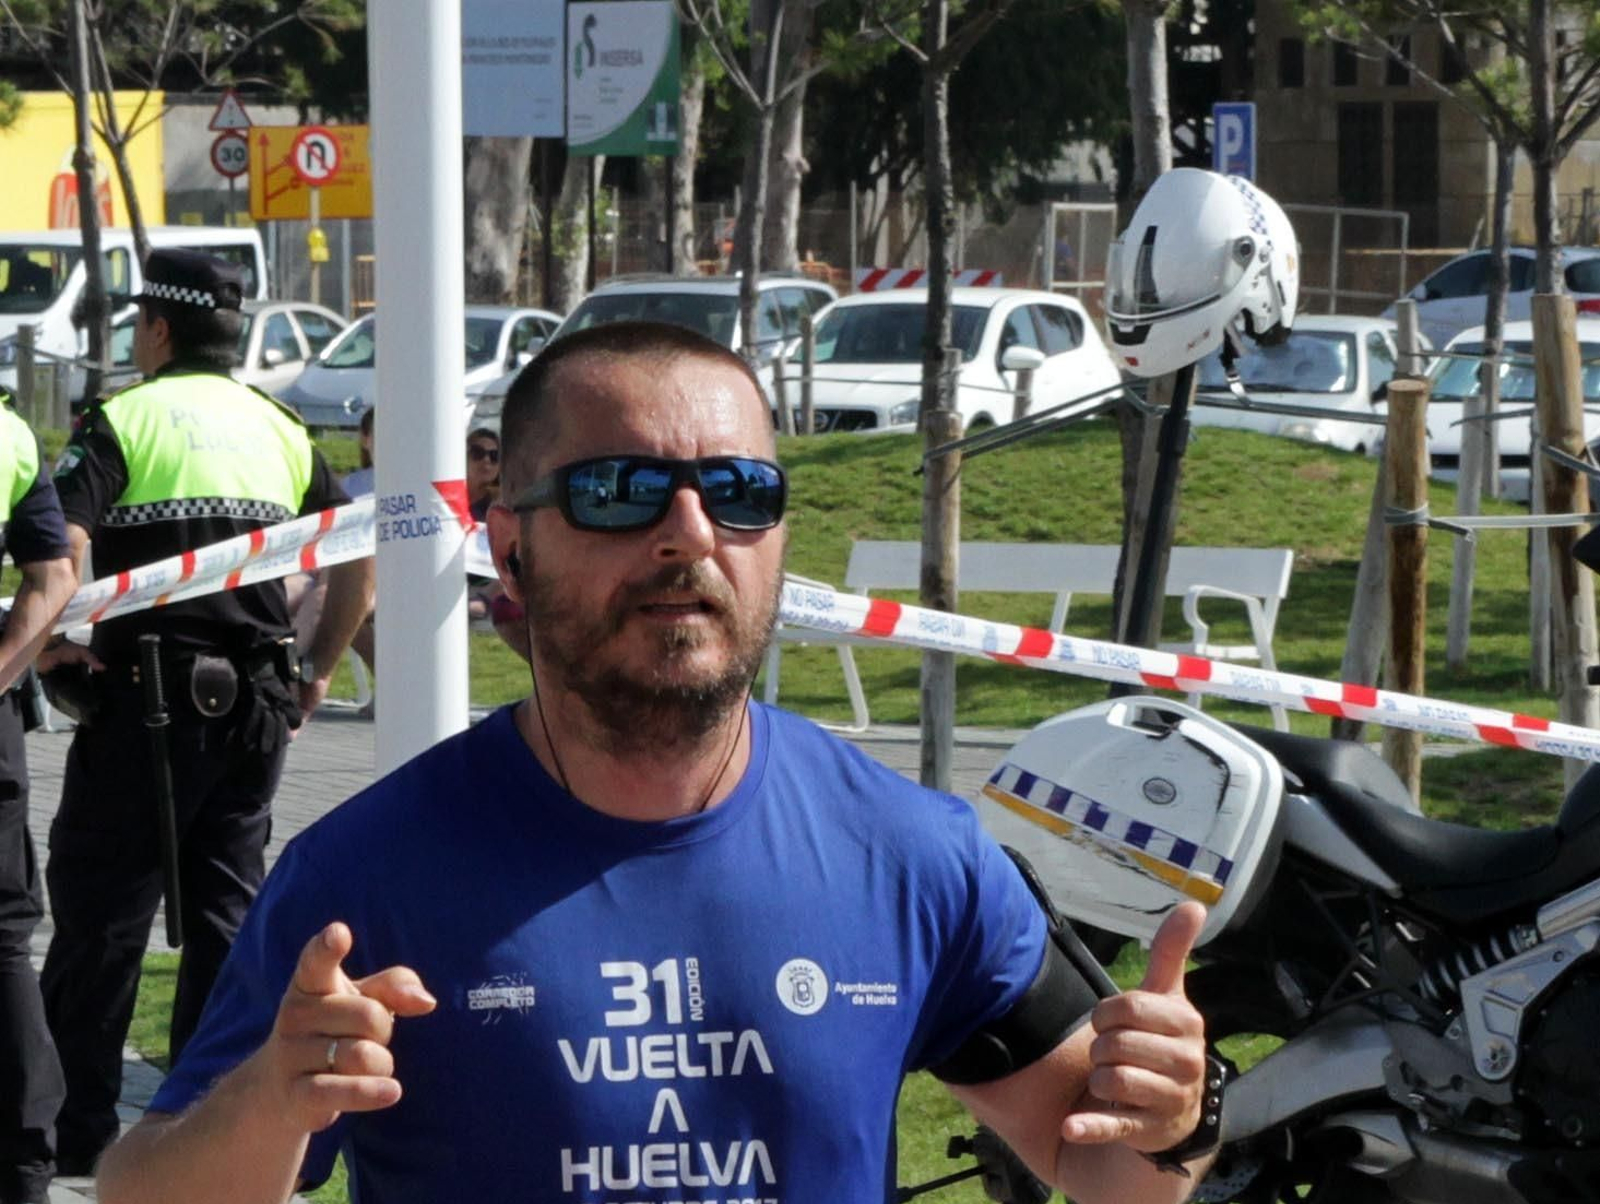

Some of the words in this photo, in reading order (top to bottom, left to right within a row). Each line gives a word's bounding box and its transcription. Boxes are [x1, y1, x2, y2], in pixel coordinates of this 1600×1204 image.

[221, 146, 246, 163] 30
[1218, 114, 1244, 175] P
[599, 957, 683, 1028] 31
[685, 957, 706, 1021] EDICIÓN
[834, 981, 898, 995] Ayuntamiento
[851, 995, 864, 1006] de
[866, 994, 898, 1006] Huelva
[556, 1028, 775, 1084] VUELTA
[647, 1087, 690, 1134] A
[560, 1139, 777, 1193] HUELVA
